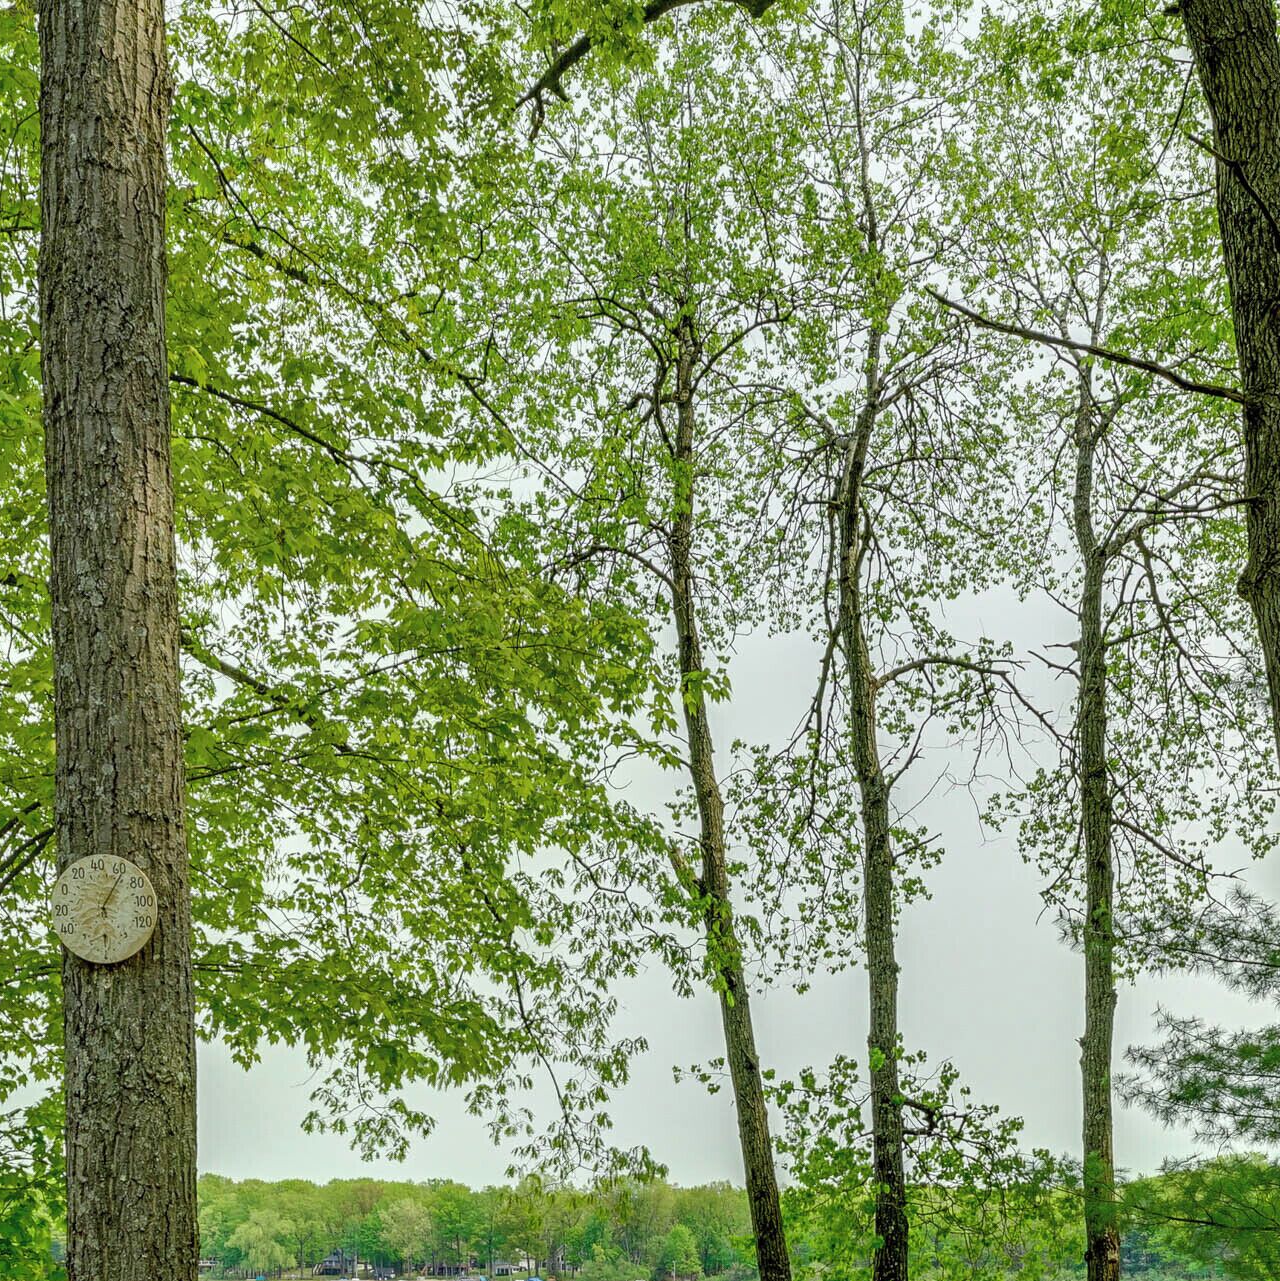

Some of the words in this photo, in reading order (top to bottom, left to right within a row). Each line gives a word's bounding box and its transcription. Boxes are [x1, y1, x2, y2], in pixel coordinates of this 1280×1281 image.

[91, 858, 104, 871] 40
[112, 862, 126, 874] 60
[72, 867, 85, 879] 20
[129, 877, 144, 888] 80
[61, 883, 68, 895] 0
[135, 896, 153, 907] 100
[55, 904, 68, 916] 20
[135, 916, 152, 928] 120
[60, 923, 74, 934] 40
